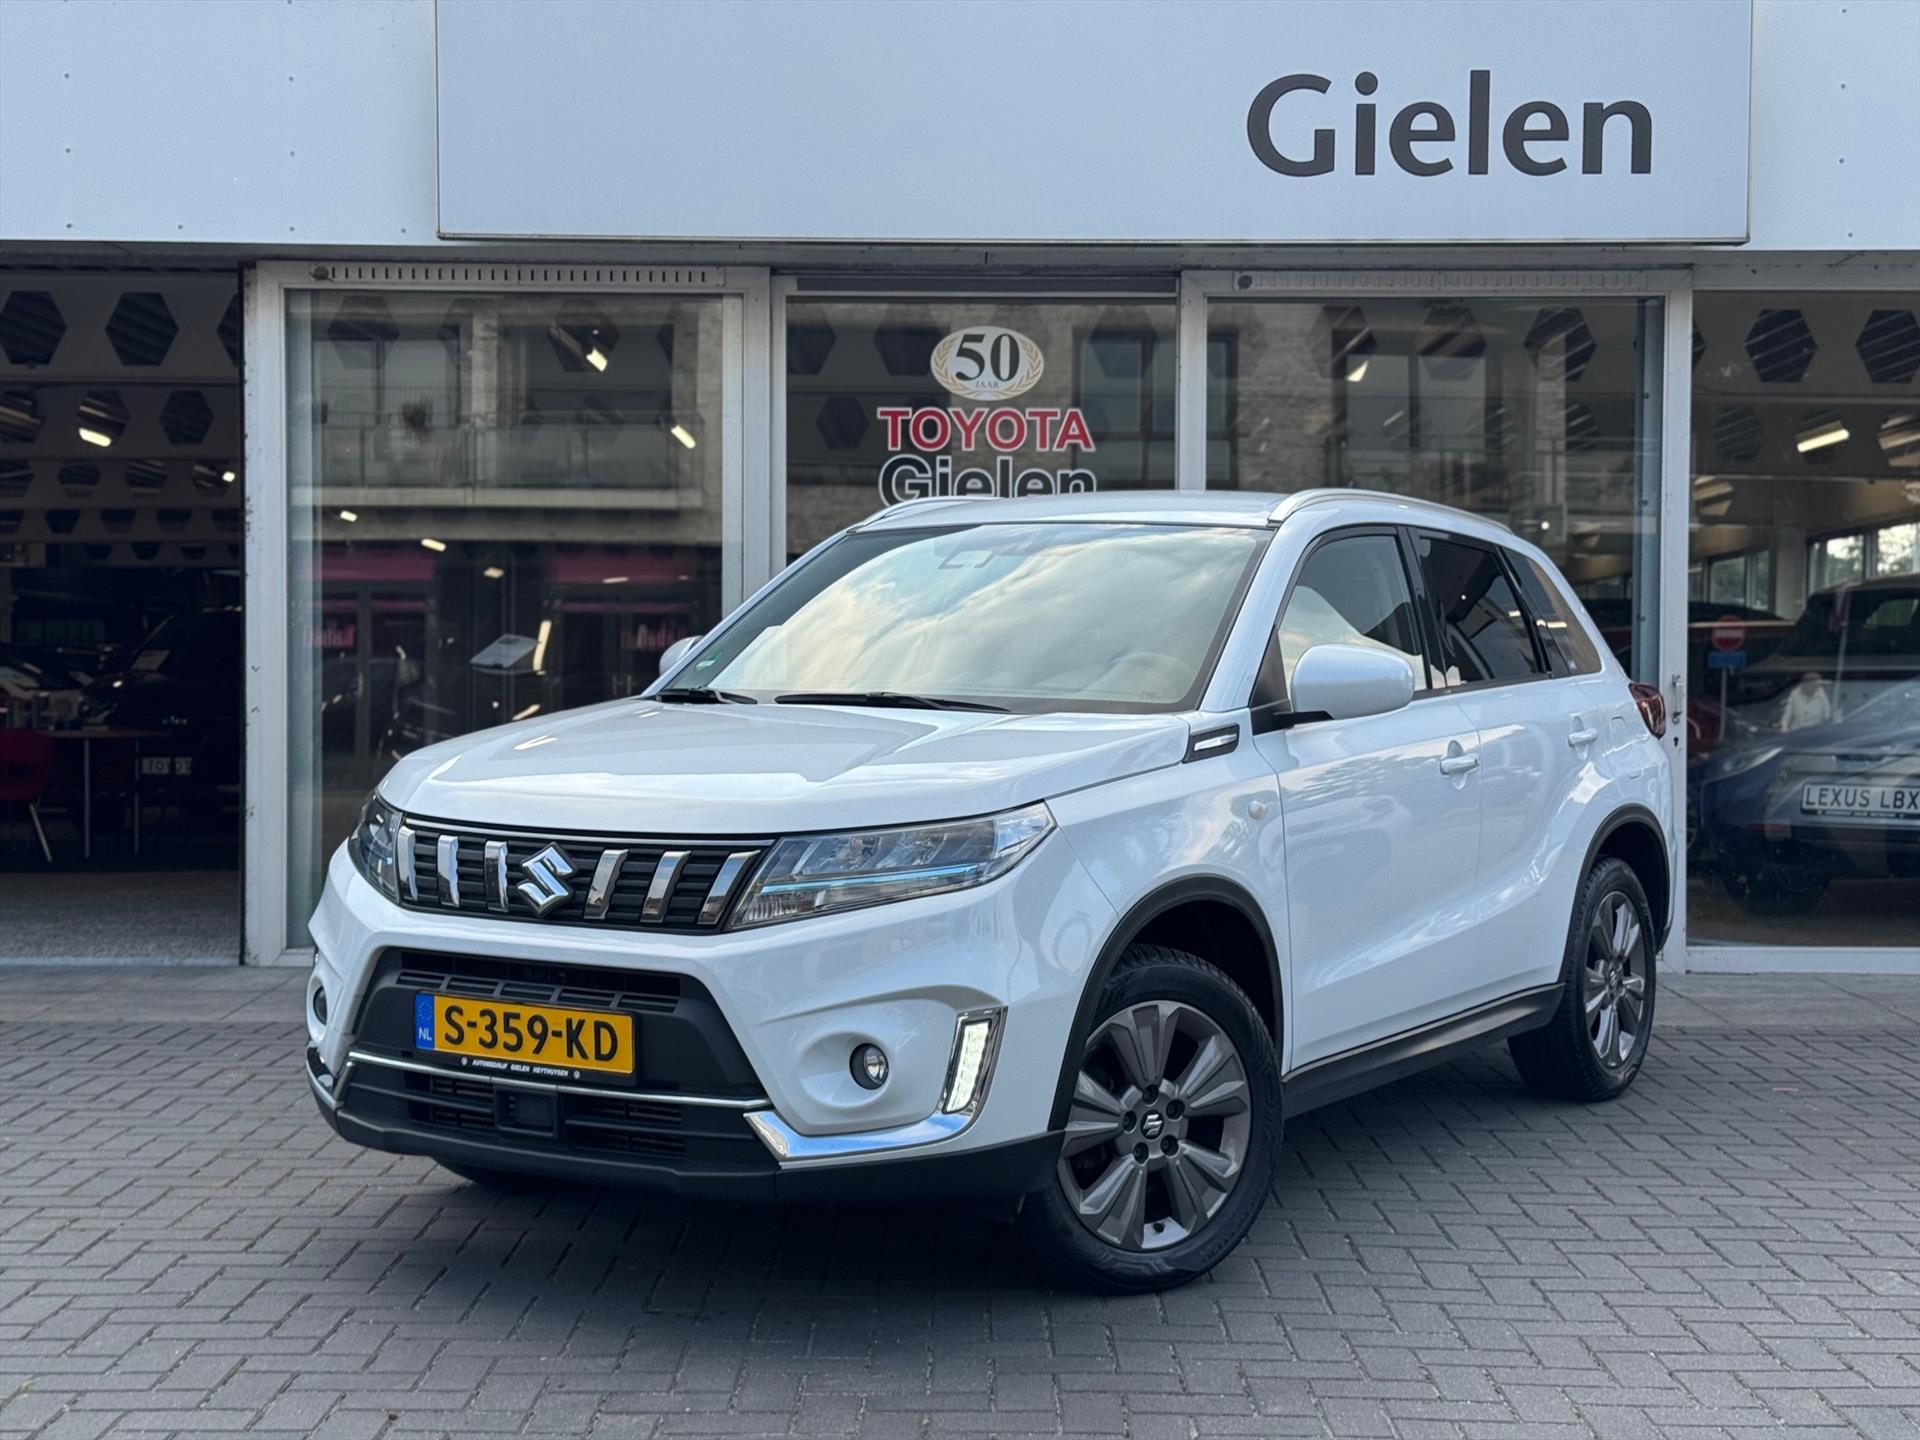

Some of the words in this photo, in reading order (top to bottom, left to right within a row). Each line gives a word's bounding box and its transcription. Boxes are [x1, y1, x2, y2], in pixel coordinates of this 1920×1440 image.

[1246, 69, 1653, 178] Gielen
[955, 333, 1020, 382] 50
[975, 380, 1000, 390] JAAR
[877, 407, 1096, 451] TOYOTA
[878, 454, 1097, 509] Gielen
[1805, 787, 1871, 808] LEXUS
[1880, 790, 1920, 810] LBX
[418, 1026, 433, 1042] NL
[444, 1004, 619, 1063] S-359-KD
